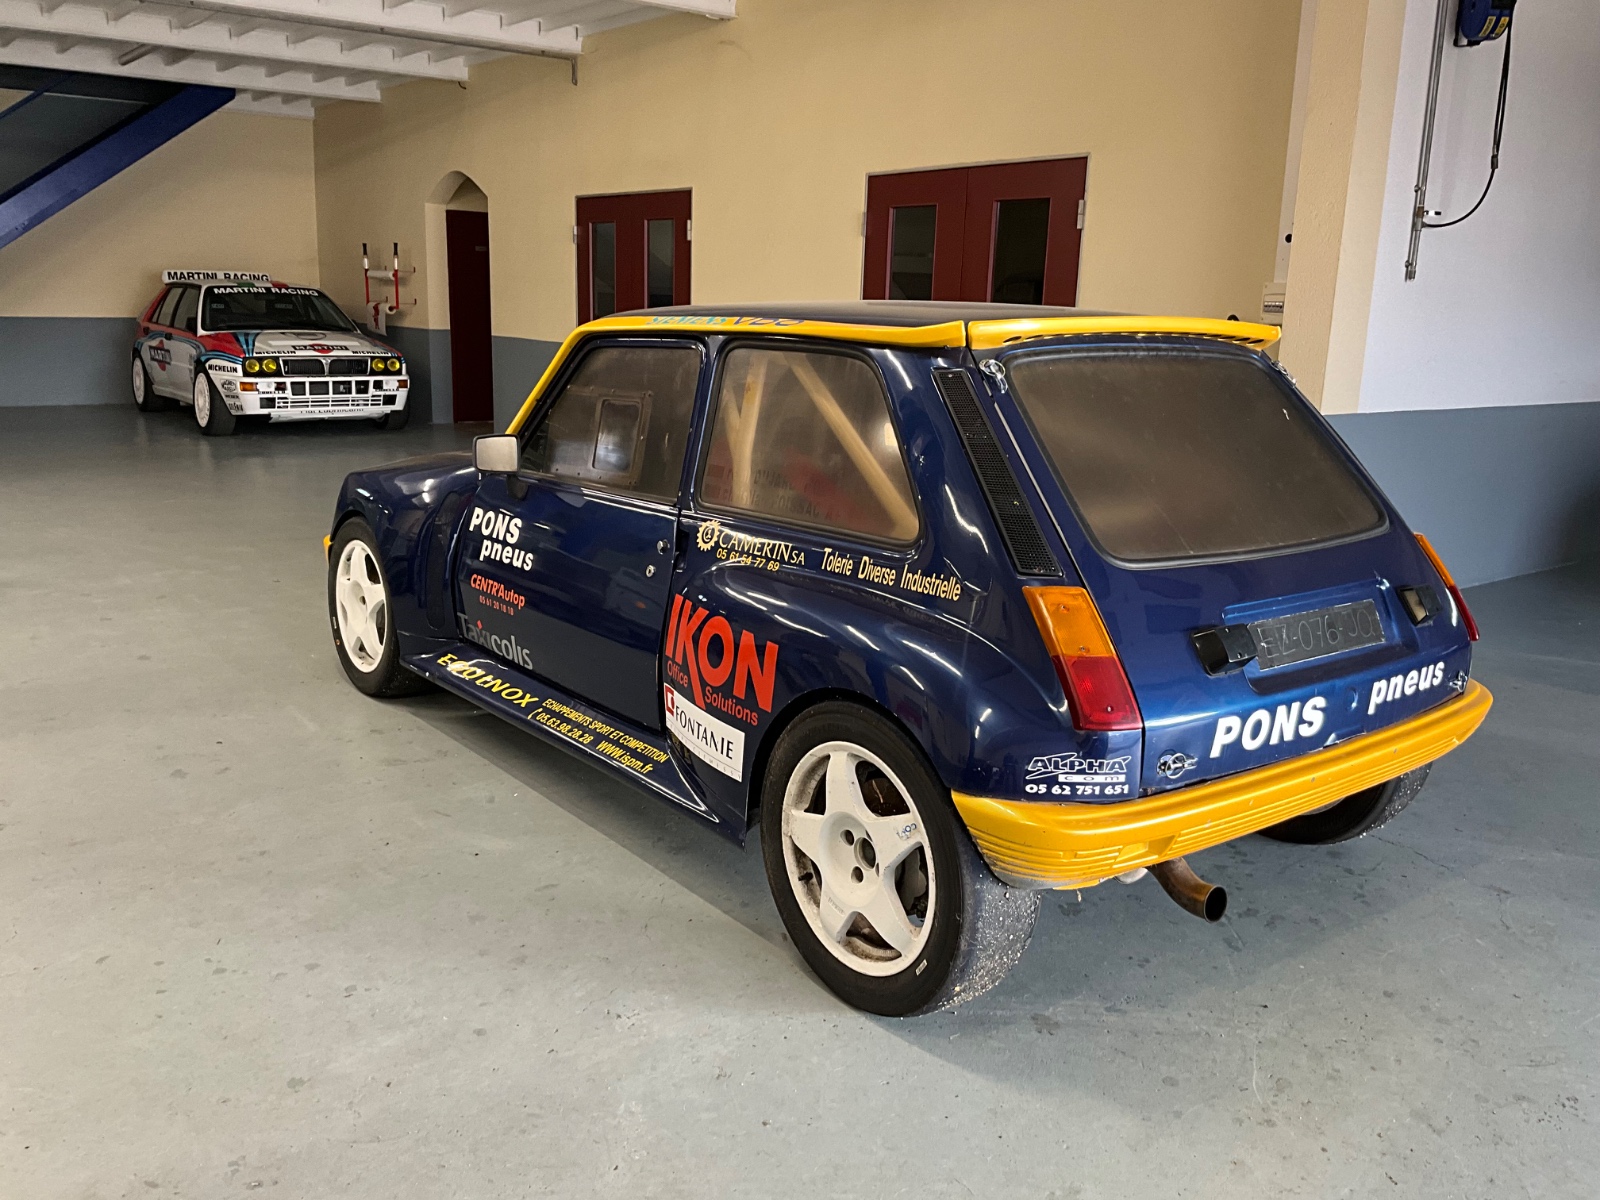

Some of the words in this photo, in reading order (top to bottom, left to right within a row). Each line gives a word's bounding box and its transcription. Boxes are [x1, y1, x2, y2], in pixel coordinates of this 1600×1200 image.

[167, 271, 218, 280] MARTINI
[223, 272, 270, 282] RACING
[271, 287, 319, 297] RACING
[207, 363, 238, 374] MICHELIN
[469, 507, 523, 545] PONS
[479, 538, 534, 571] pneus
[716, 549, 728, 559] 05
[729, 552, 740, 562] 61
[740, 554, 752, 565] 54
[753, 557, 766, 568] 77
[767, 561, 780, 571] 69
[719, 531, 793, 562] CAMERIN
[790, 550, 805, 565] SA
[821, 547, 853, 576] Tolerie
[858, 556, 896, 586] Diverse
[900, 564, 961, 601] Industrielle
[457, 612, 533, 670] Taxicolis
[665, 593, 779, 713] IKON
[667, 661, 688, 688] Office
[705, 686, 758, 726] Solutions
[1209, 696, 1327, 759] PONS
[1367, 661, 1445, 716] pneus
[536, 712, 594, 744] 05.63.98.28.28
[596, 740, 654, 774] WWW.ispm.fr
[542, 698, 592, 726] ECHAPPEMENTS
[589, 720, 615, 736] SPORT
[609, 730, 624, 740] ET
[619, 735, 670, 763] COMPETITION
[675, 705, 734, 760] FONTANIE
[1026, 753, 1130, 776] ALPHA
[1025, 783, 1047, 794] 05
[1051, 784, 1071, 795] 62
[1075, 785, 1100, 795] 751
[1104, 784, 1129, 795] 651
